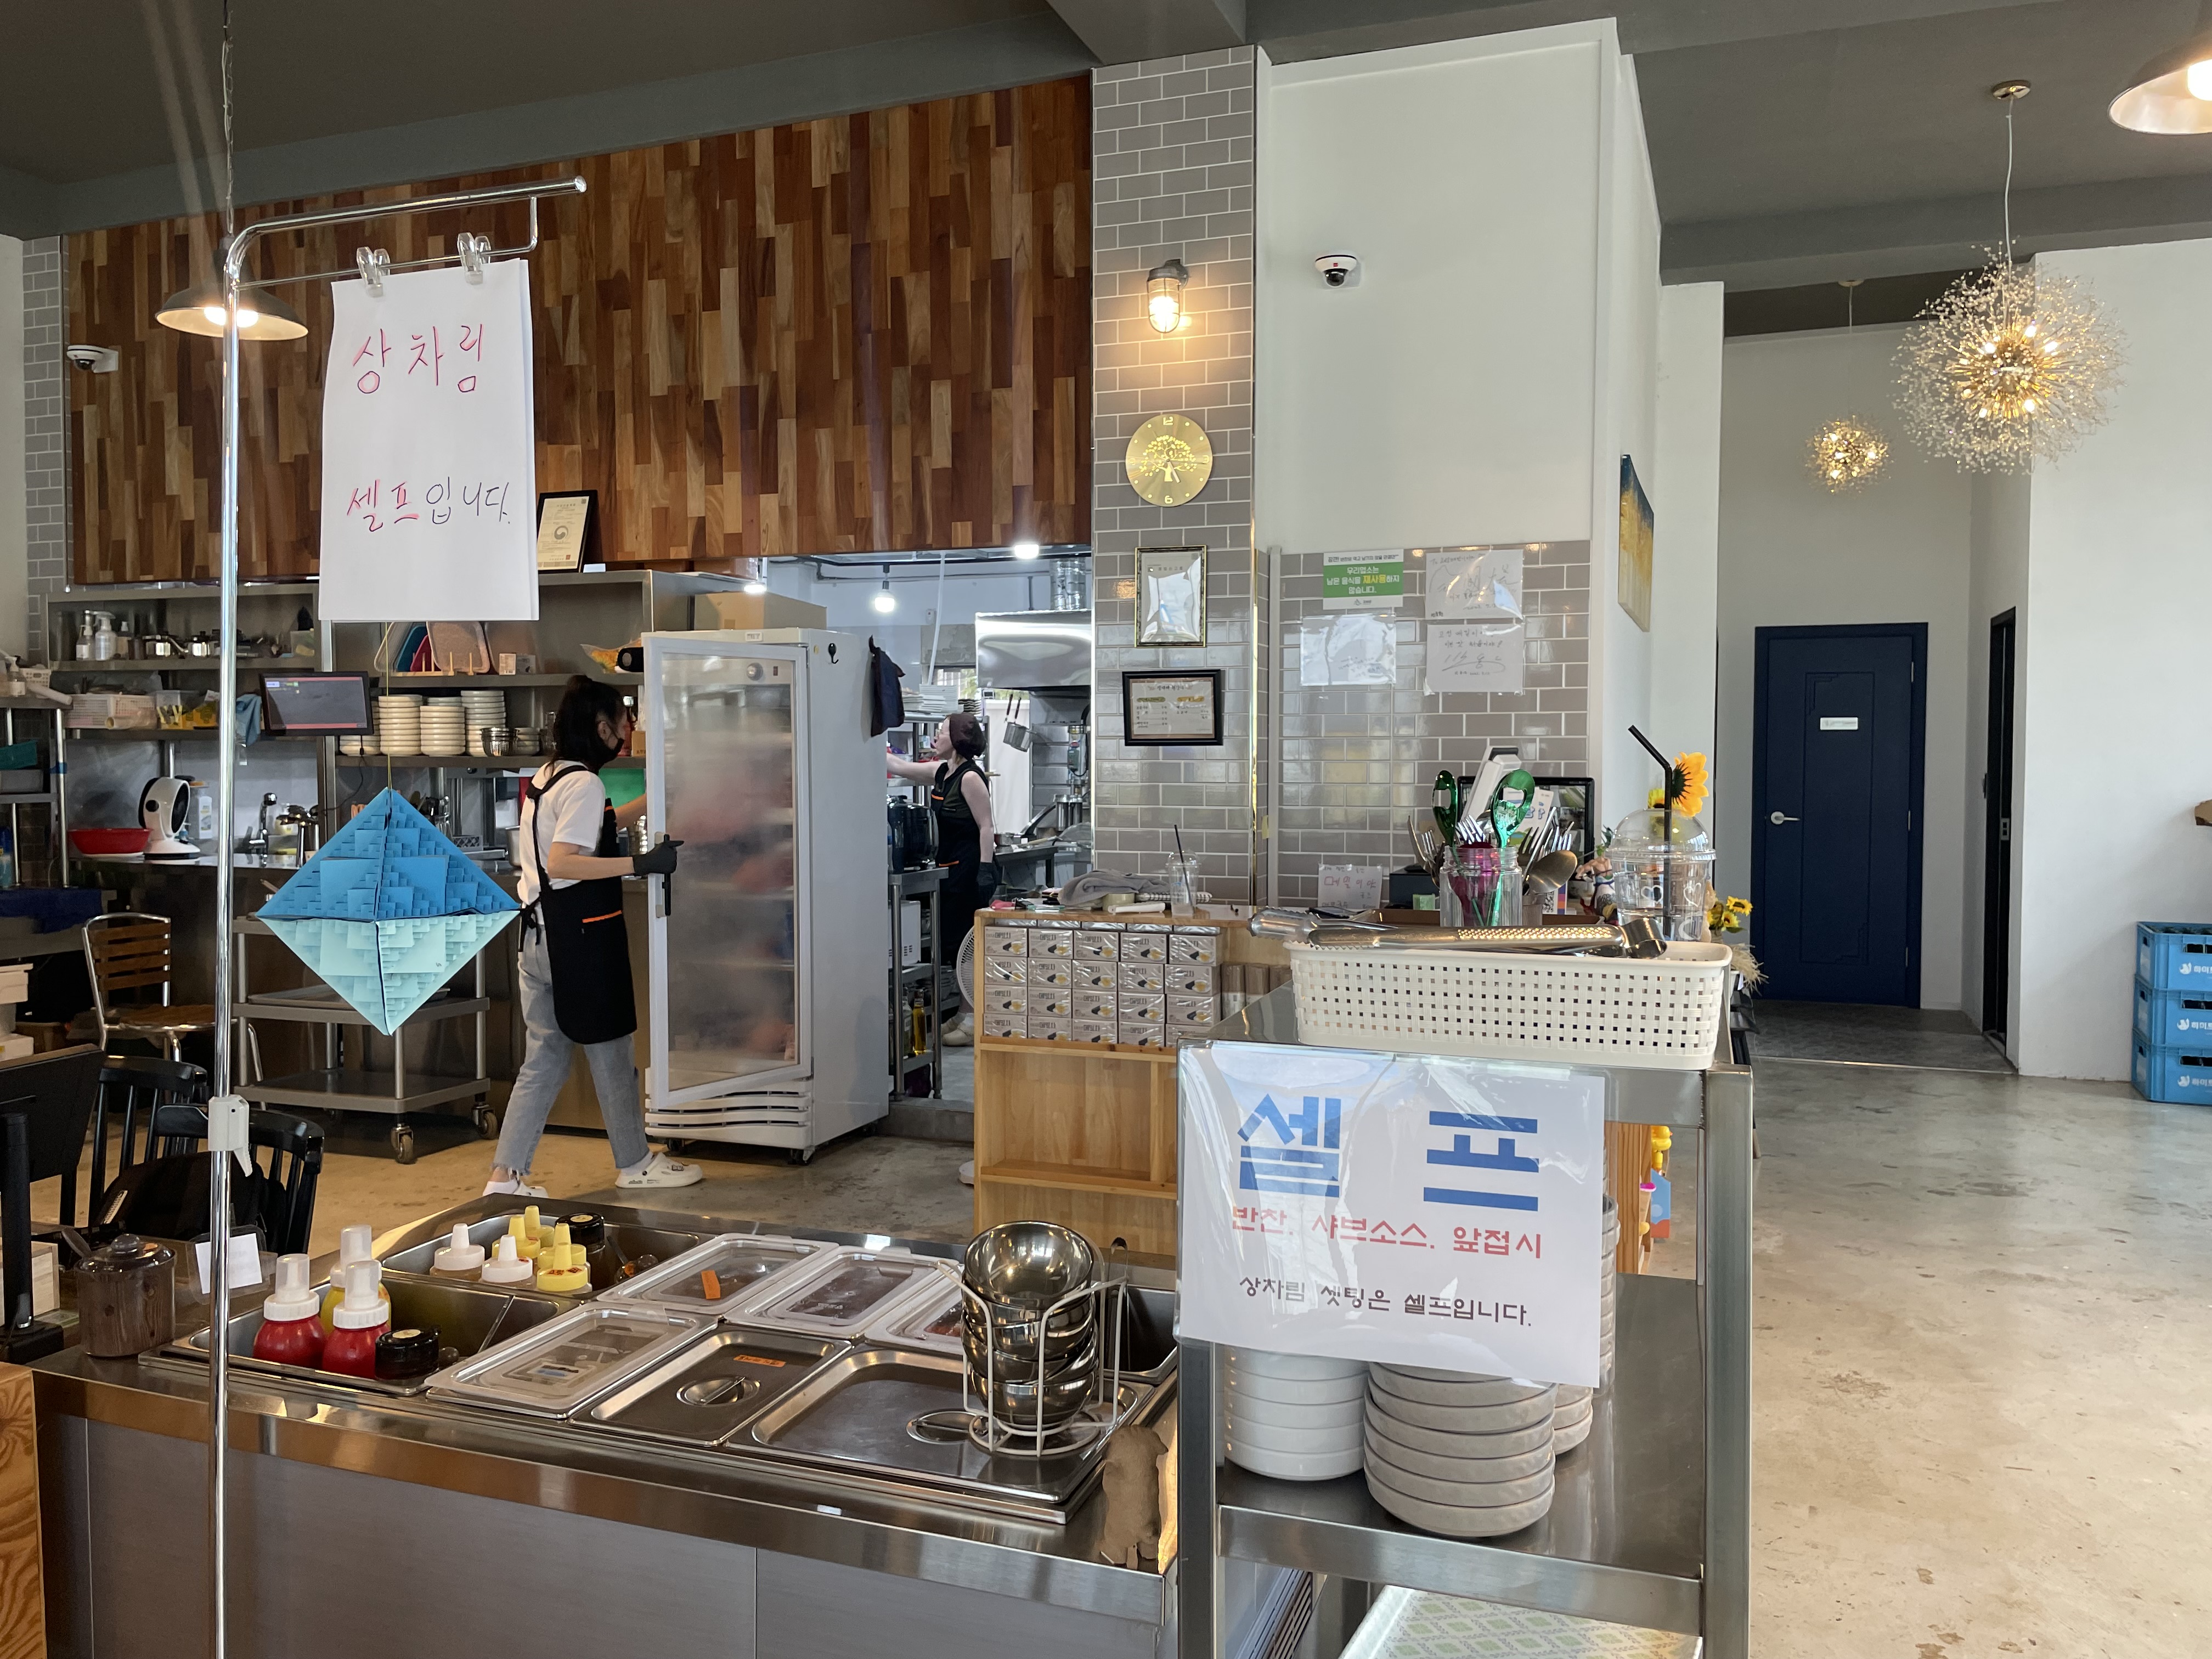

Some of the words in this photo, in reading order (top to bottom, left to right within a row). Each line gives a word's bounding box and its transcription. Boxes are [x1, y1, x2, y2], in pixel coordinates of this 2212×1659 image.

[353, 323, 484, 394] 상차림
[1163, 416, 1173, 426] 12
[347, 476, 511, 532] 셀프입니다.
[1164, 495, 1173, 504] 6
[1347, 566, 1379, 575] 우리업소는
[1453, 1226, 1541, 1259] 앞접시
[1404, 1293, 1532, 1327] 셀프입니다.
